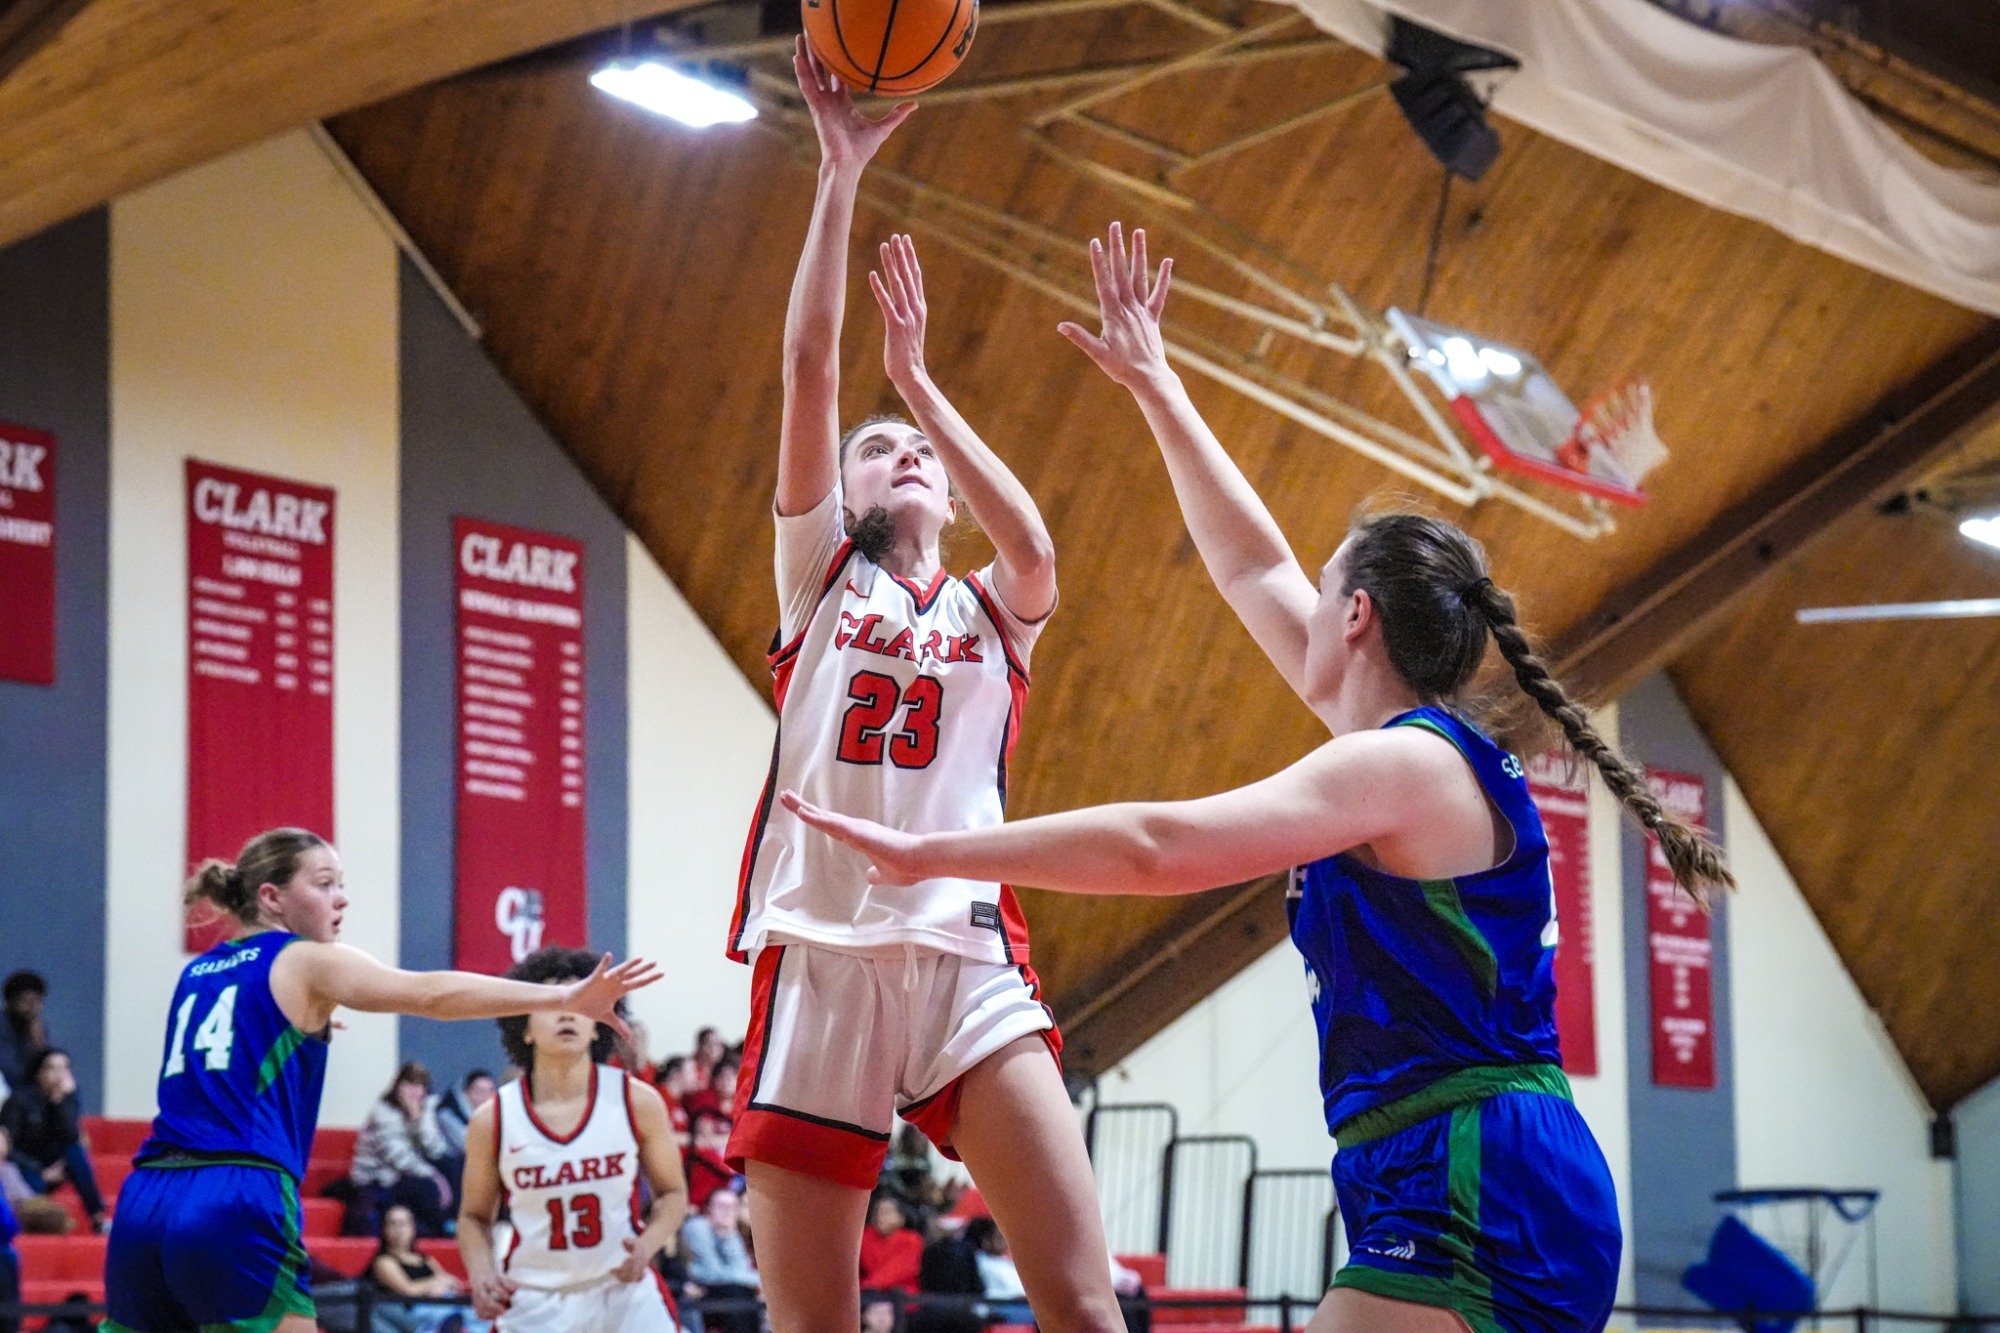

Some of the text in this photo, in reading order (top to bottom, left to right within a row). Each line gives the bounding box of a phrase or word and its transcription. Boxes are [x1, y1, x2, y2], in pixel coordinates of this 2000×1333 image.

[193, 476, 328, 545] CLARK
[460, 532, 577, 592] CLARK
[834, 610, 983, 668] CLARK
[836, 669, 944, 769] 23
[164, 984, 238, 1075] 14
[513, 1152, 626, 1190] CLARK
[546, 1193, 603, 1250] 13
